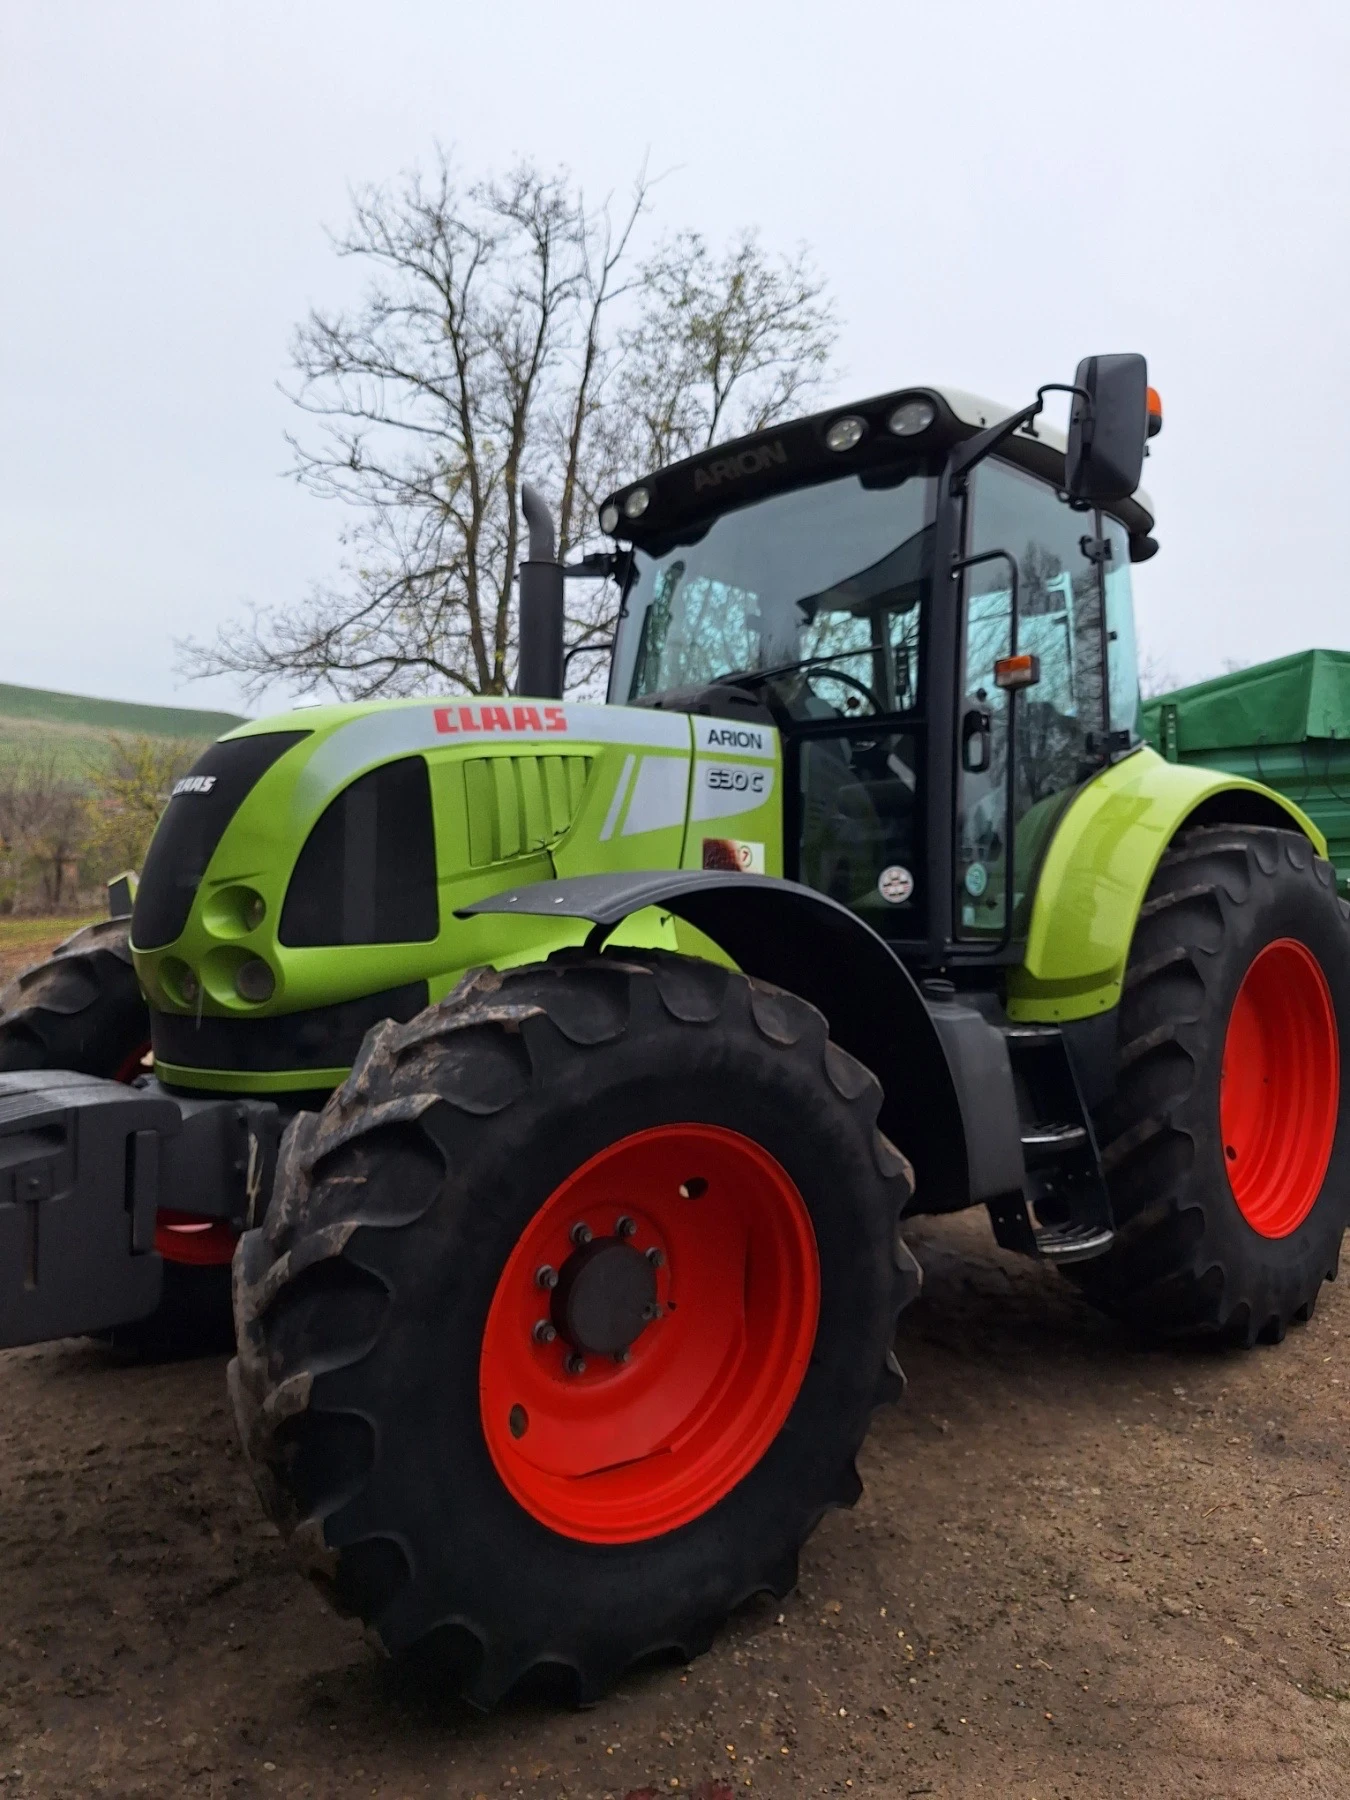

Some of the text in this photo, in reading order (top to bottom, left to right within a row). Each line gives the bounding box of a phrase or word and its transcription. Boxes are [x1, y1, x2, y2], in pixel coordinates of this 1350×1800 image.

[694, 440, 787, 492] ARION
[433, 706, 567, 733] CLAAS
[708, 729, 762, 749] ARION
